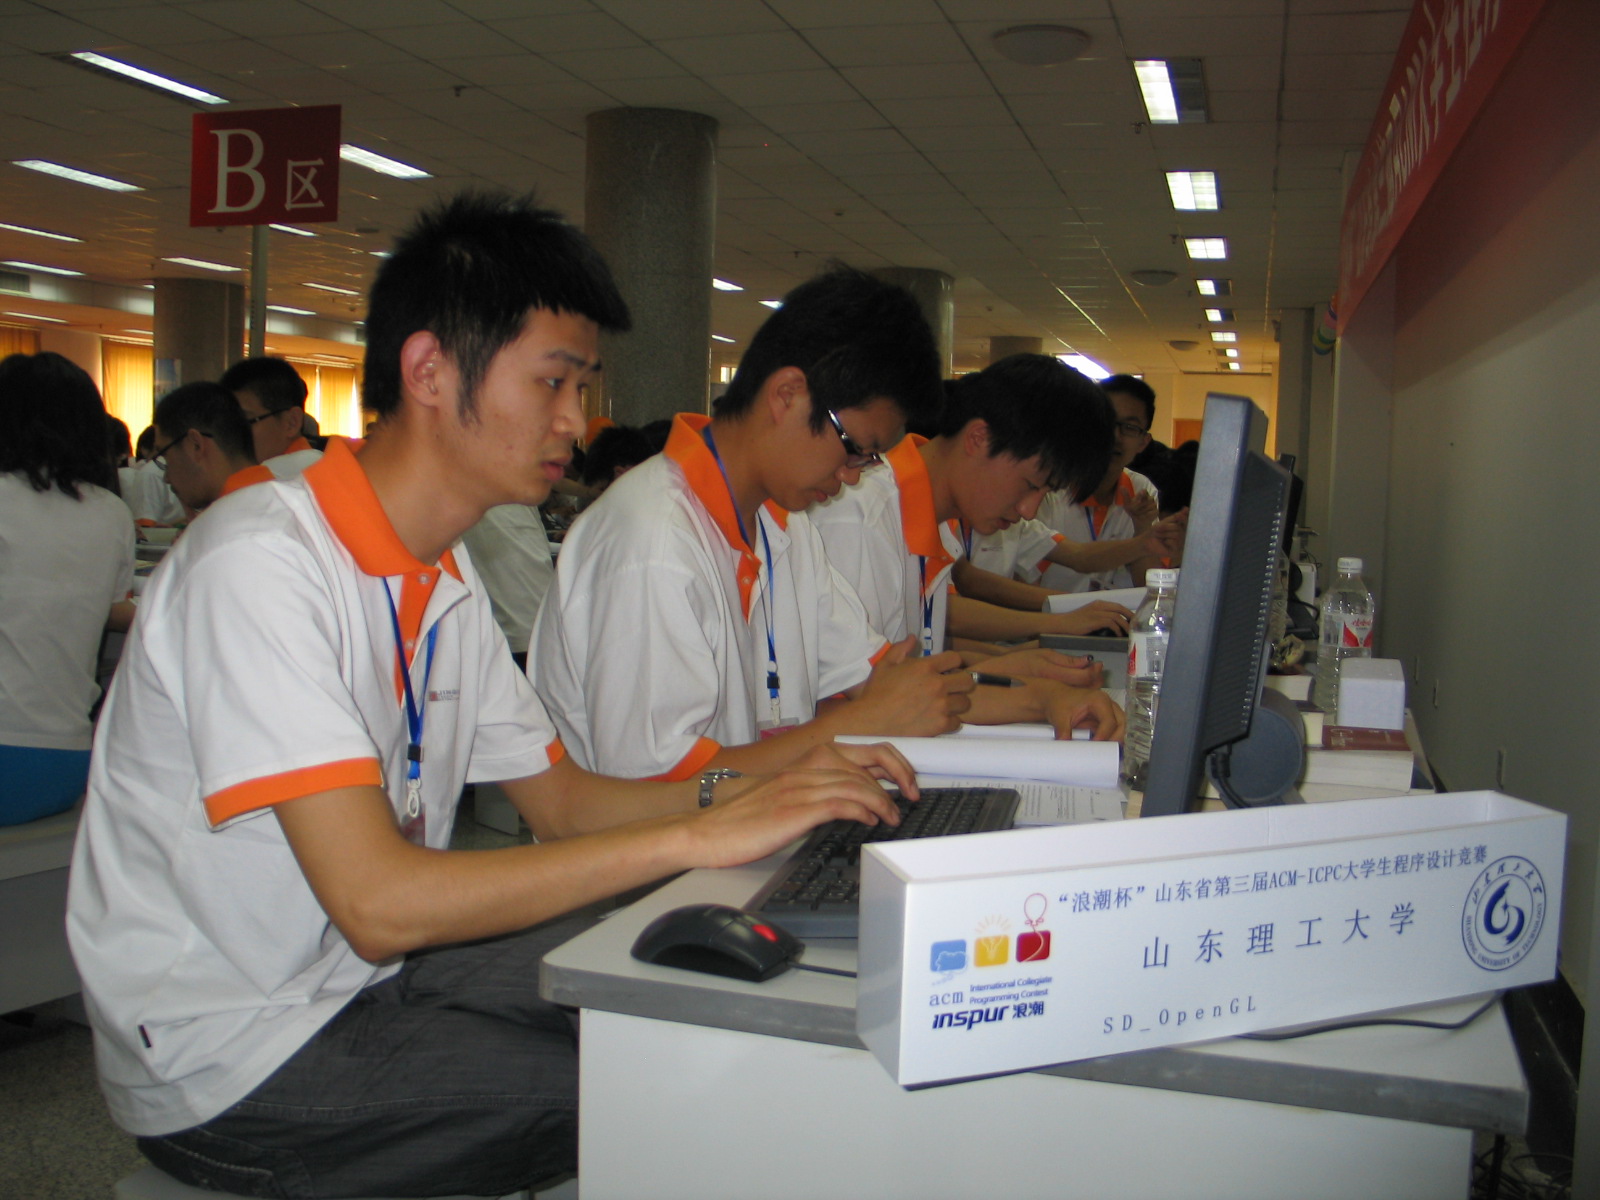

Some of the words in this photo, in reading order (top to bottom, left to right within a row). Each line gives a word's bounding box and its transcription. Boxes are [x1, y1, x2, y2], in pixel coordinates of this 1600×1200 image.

[1142, 901, 1415, 969] 山东理工大学
[970, 979, 1016, 992] International
[1017, 976, 1052, 988] Collegiate
[929, 991, 964, 1007] acm
[969, 992, 1019, 1006] Programming
[1020, 988, 1048, 999] Contest
[932, 1005, 1010, 1030] inspur
[1012, 1001, 1044, 1019] 浪潮
[1103, 996, 1257, 1034] SD_OpenGL
